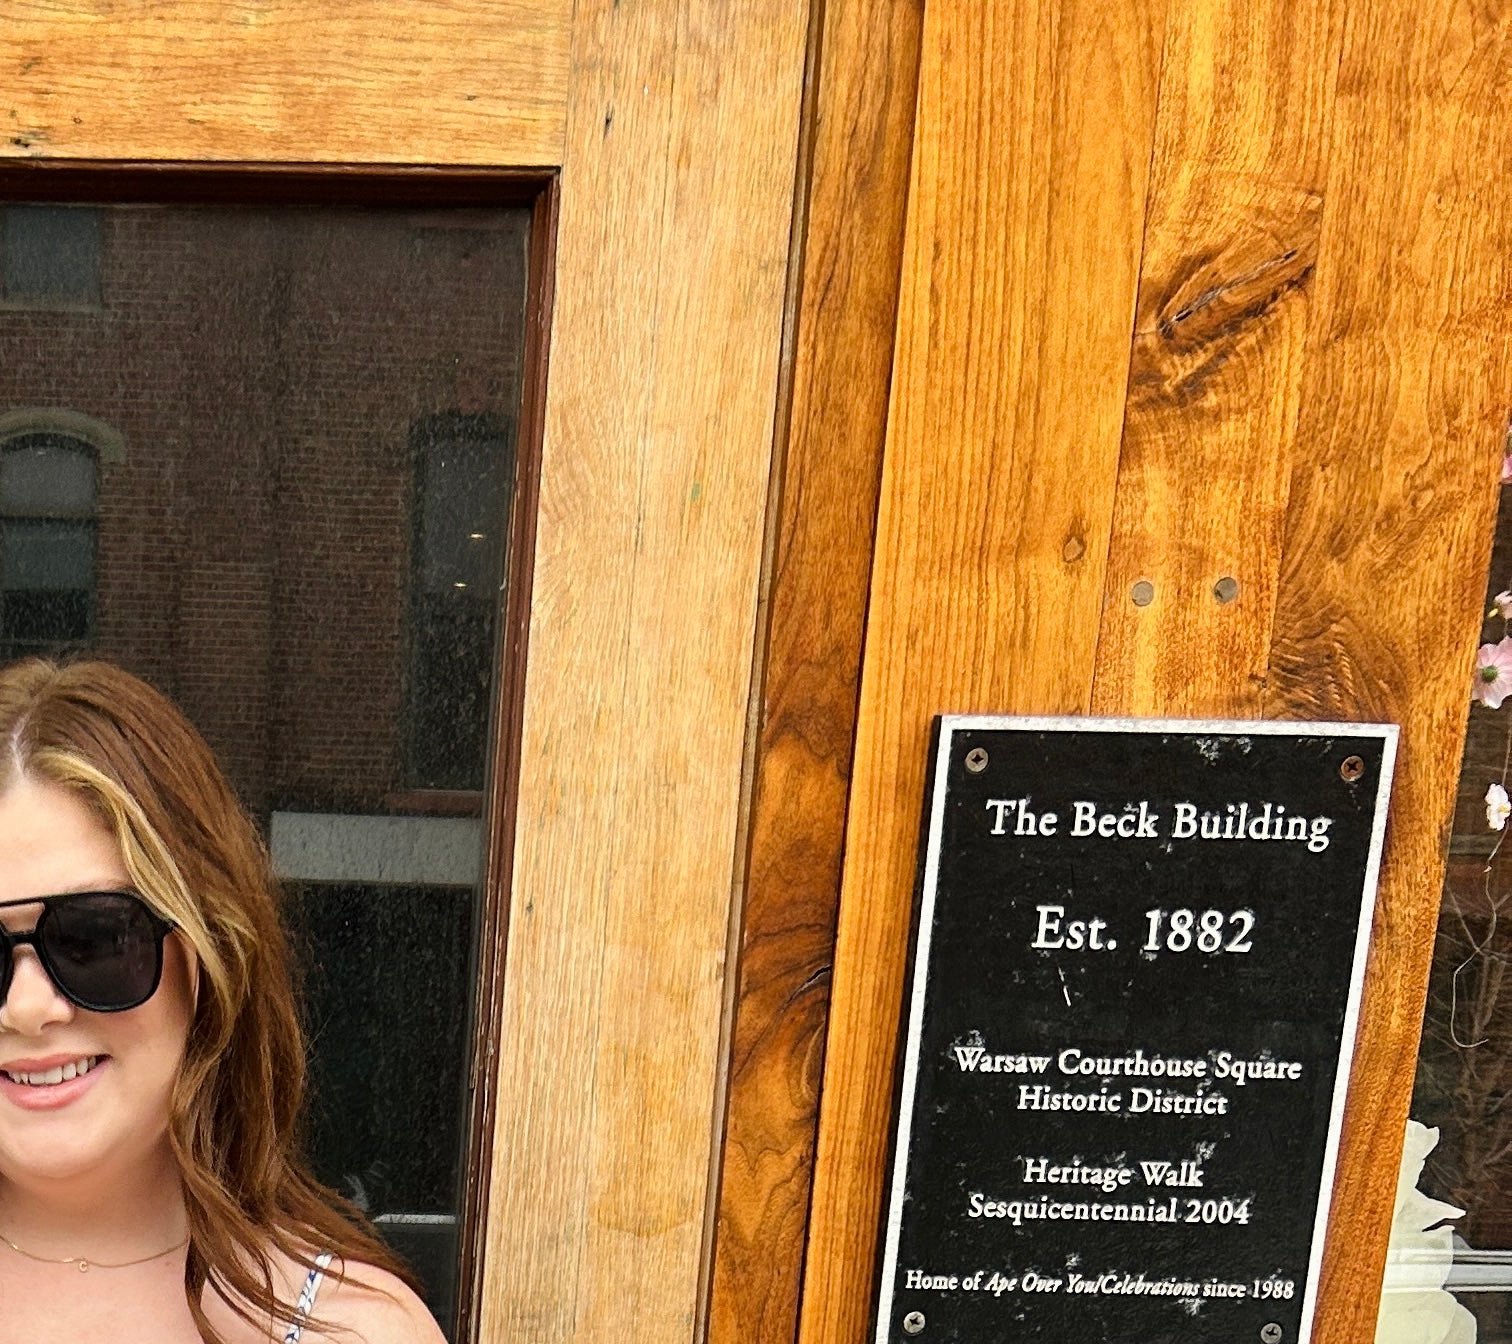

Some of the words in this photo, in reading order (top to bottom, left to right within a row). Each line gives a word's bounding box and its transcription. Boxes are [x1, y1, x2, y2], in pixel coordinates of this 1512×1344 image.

[985, 798, 1058, 837] The
[1070, 801, 1159, 838] Beck
[1172, 802, 1333, 852] Building
[1030, 905, 1117, 951] Est.
[1143, 908, 1256, 953] 1882
[953, 1046, 1051, 1074] Warsaw
[1058, 1048, 1207, 1078] Courthouse
[1215, 1052, 1303, 1082] Square
[1016, 1084, 1121, 1112] Historic
[1129, 1087, 1228, 1115] District
[1023, 1157, 1132, 1191] Heritage
[1139, 1160, 1204, 1187] Walk
[968, 1193, 1177, 1226] Sesquicentennial
[1185, 1197, 1250, 1225] 2004
[905, 1269, 958, 1291] Home
[962, 1270, 984, 1291] of
[1022, 1272, 1062, 1293] Over
[1202, 1277, 1247, 1298] since
[1252, 1279, 1295, 1300] 1988
